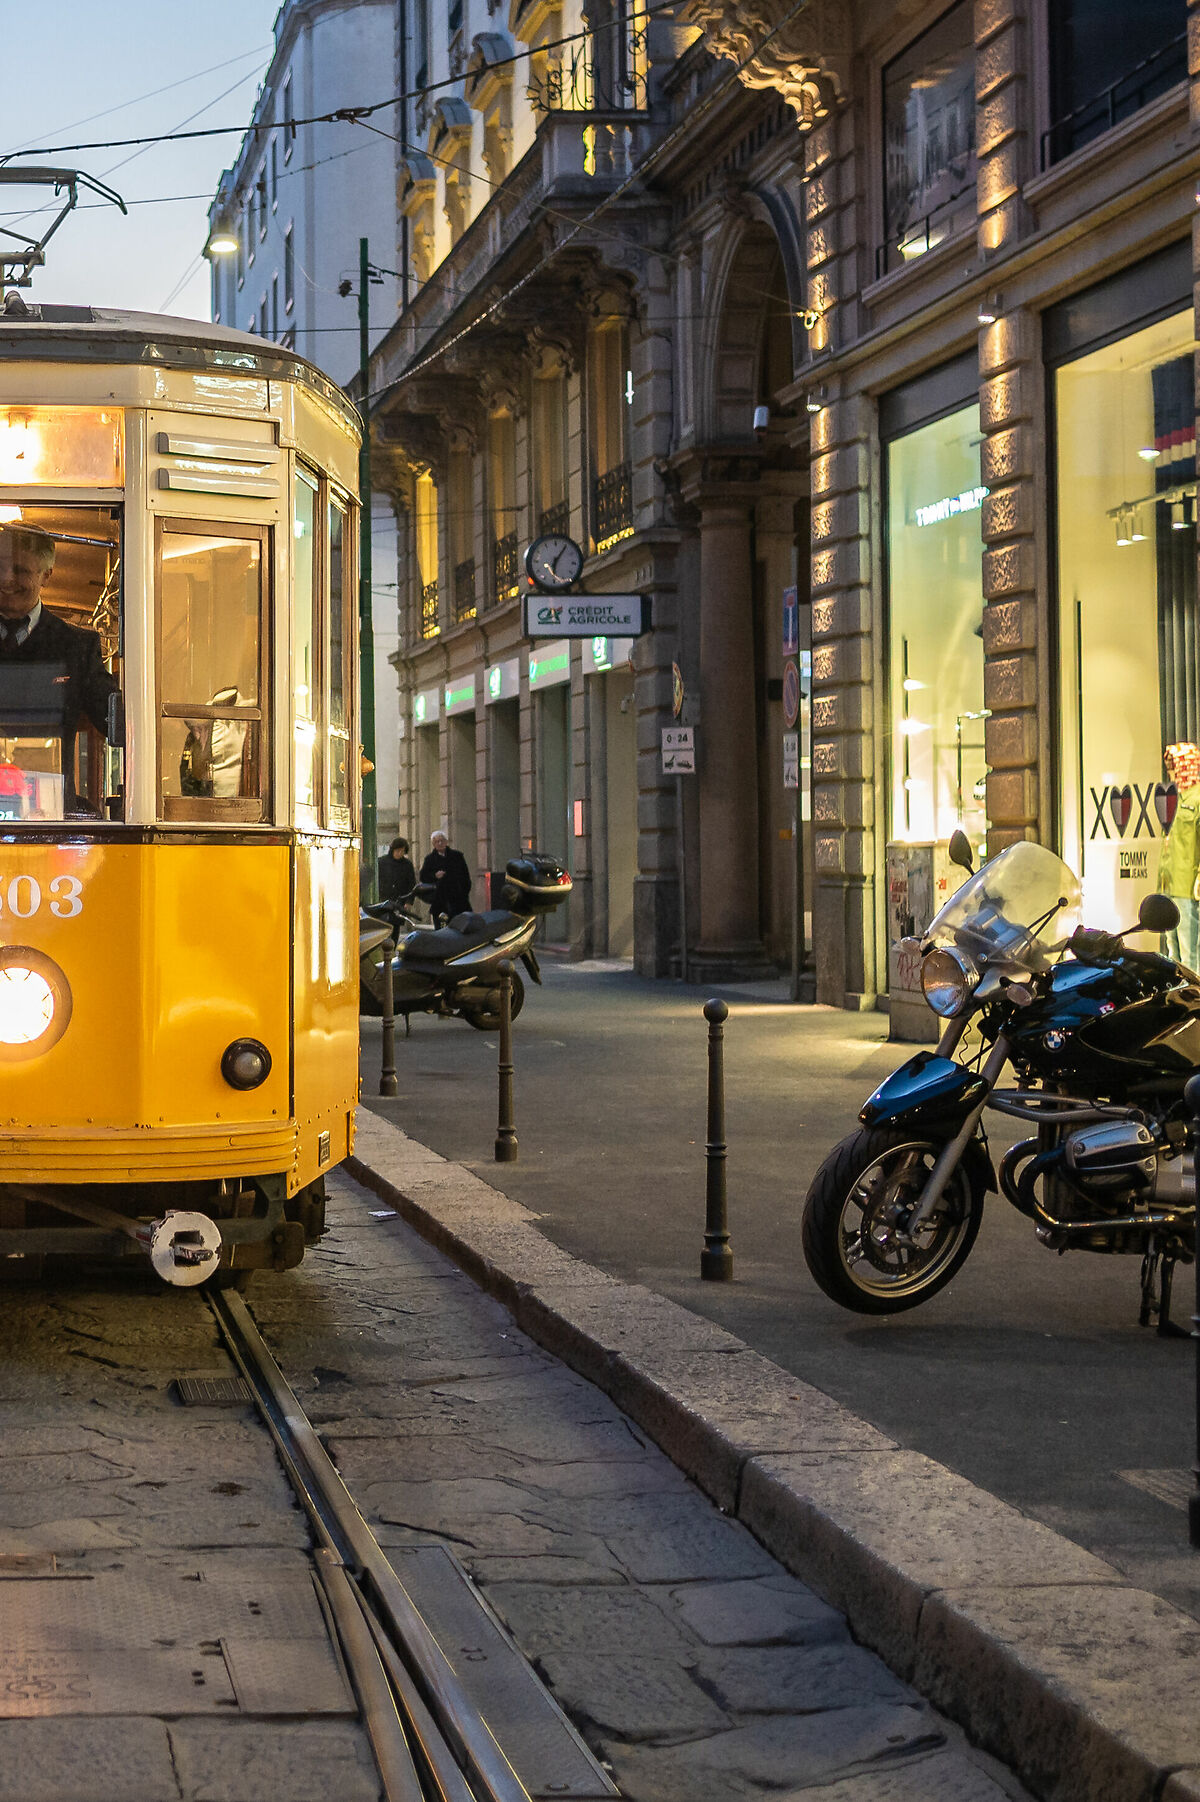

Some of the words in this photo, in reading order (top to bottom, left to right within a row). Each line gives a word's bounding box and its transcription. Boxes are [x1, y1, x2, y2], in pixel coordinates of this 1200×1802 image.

[568, 615, 631, 625] AGRICOLE
[1119, 851, 1148, 867] TOMMY
[1131, 868, 1148, 879] JEANS
